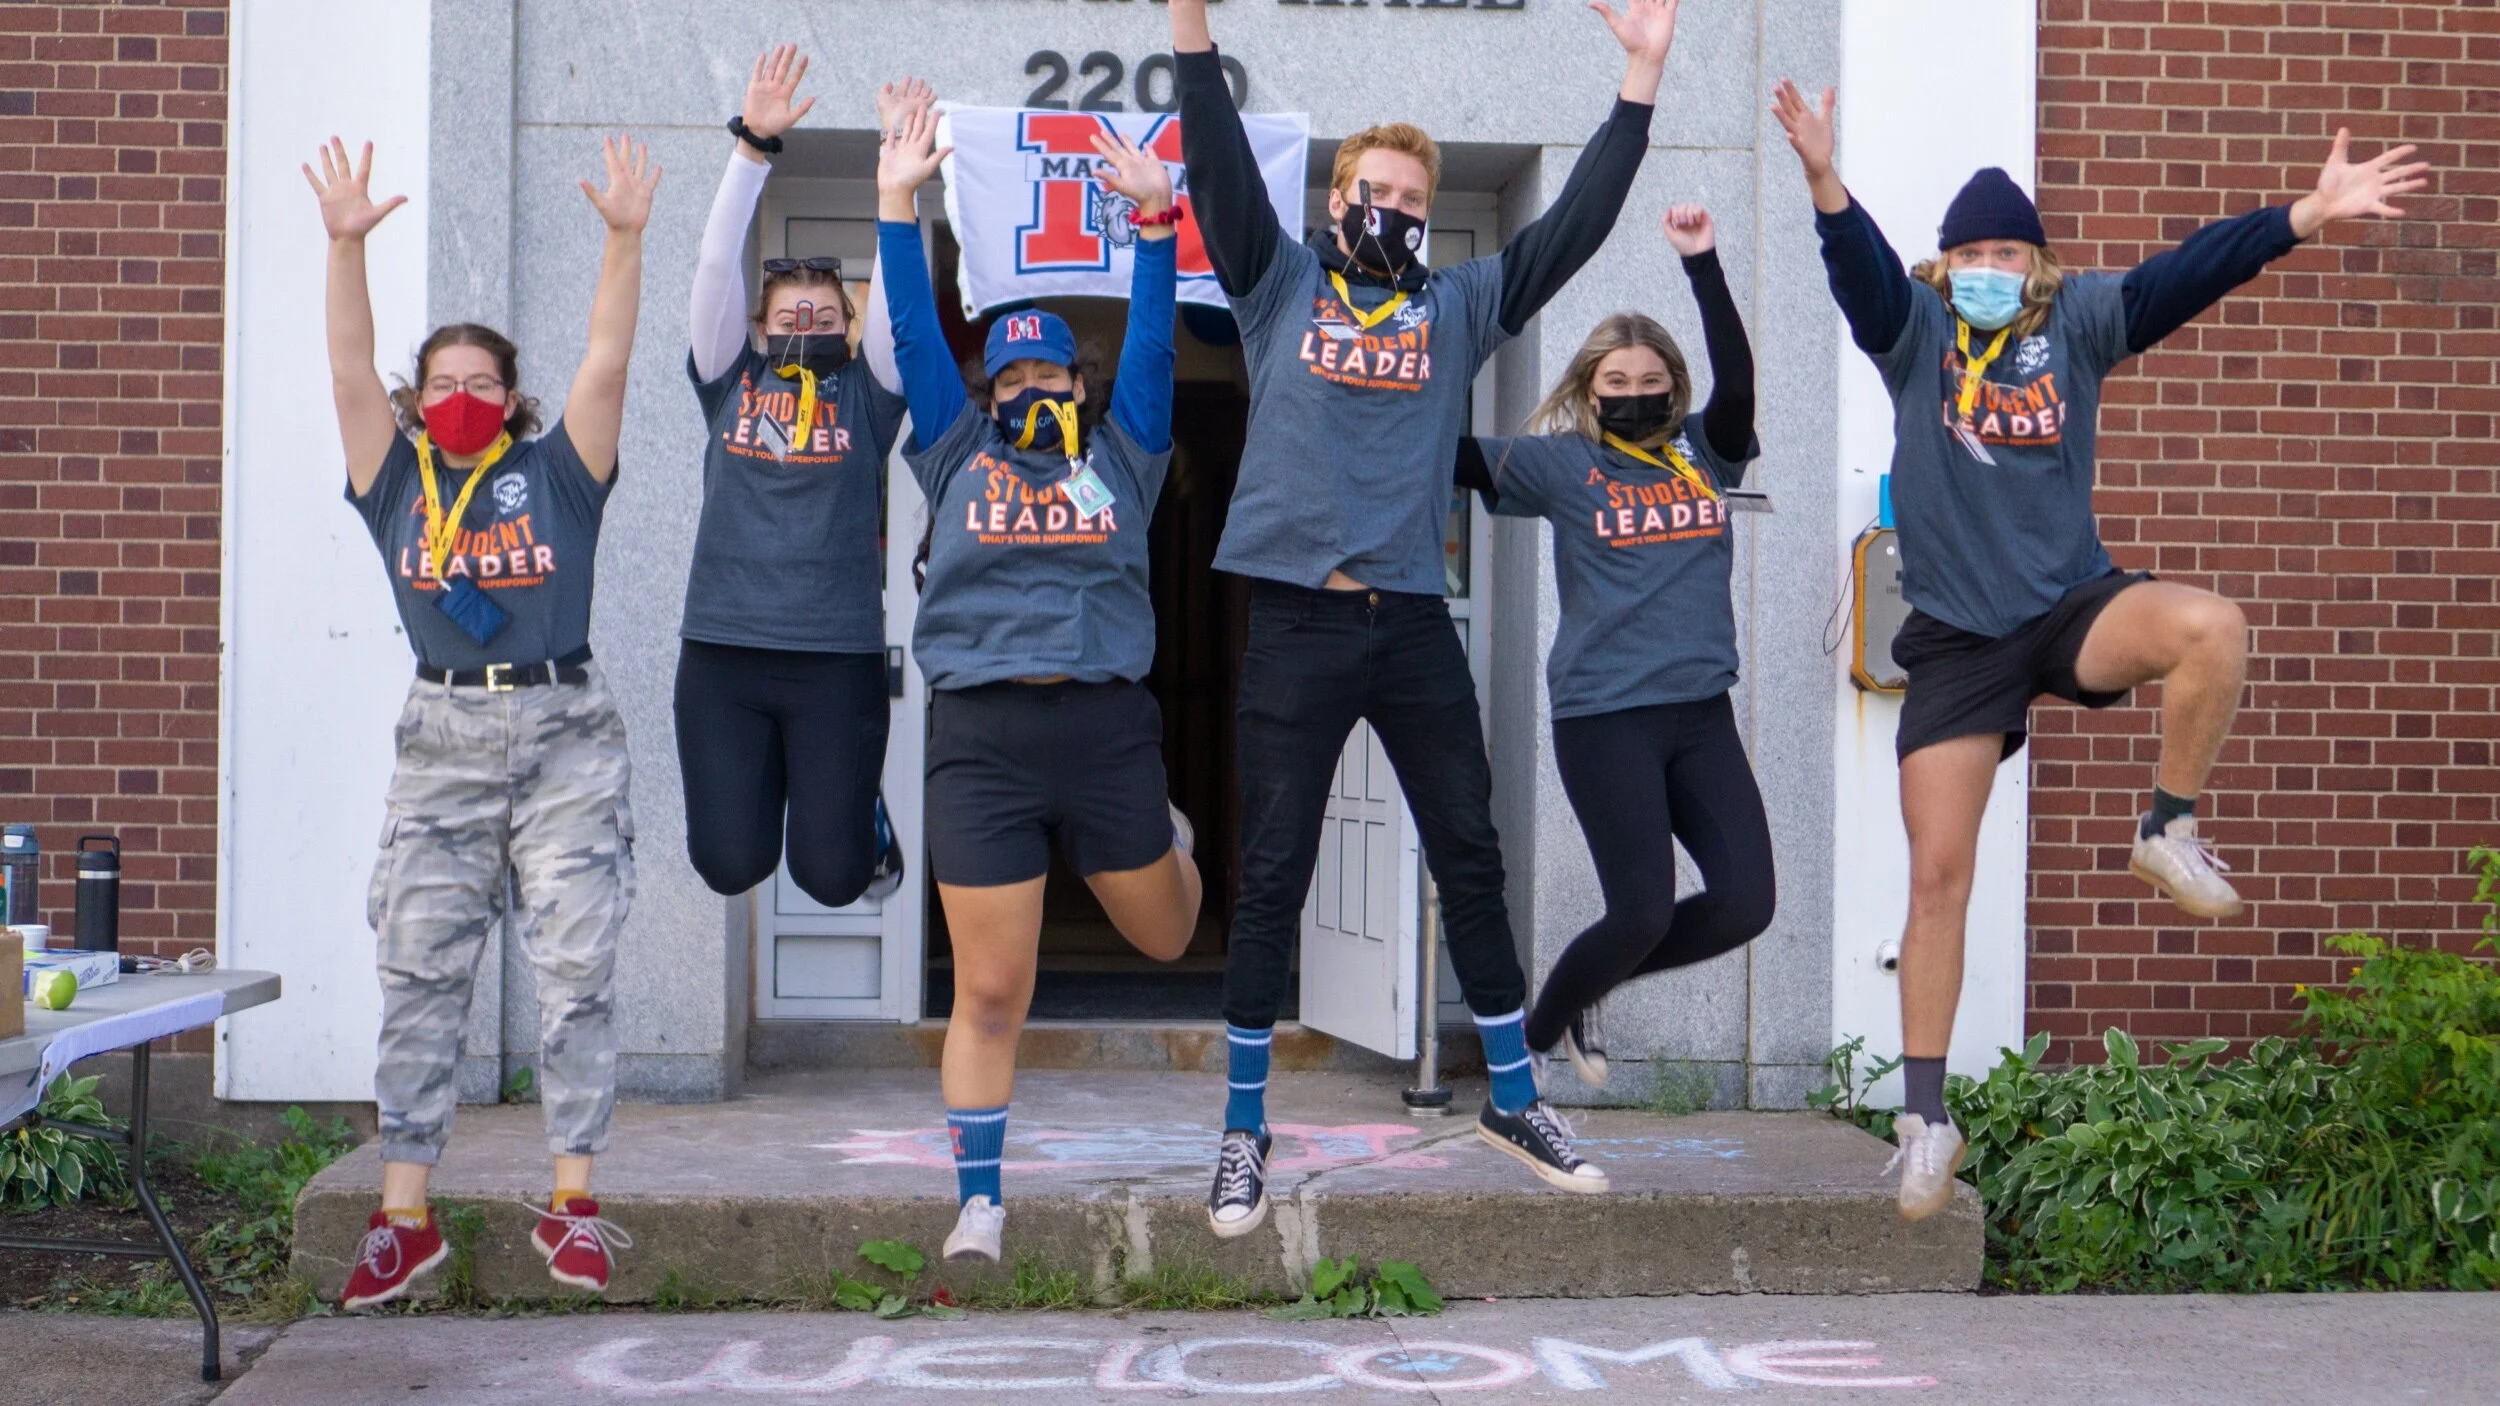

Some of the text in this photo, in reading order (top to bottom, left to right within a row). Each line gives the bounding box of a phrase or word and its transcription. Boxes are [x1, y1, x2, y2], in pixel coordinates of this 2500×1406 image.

[1299, 331, 1431, 380] LEADER
[1595, 499, 1727, 538] LEADER
[978, 534, 1014, 544] WHAT'S
[1014, 534, 1041, 544] YOUR
[400, 545, 557, 579] LEADER
[564, 1335, 1940, 1393] WELCOME
